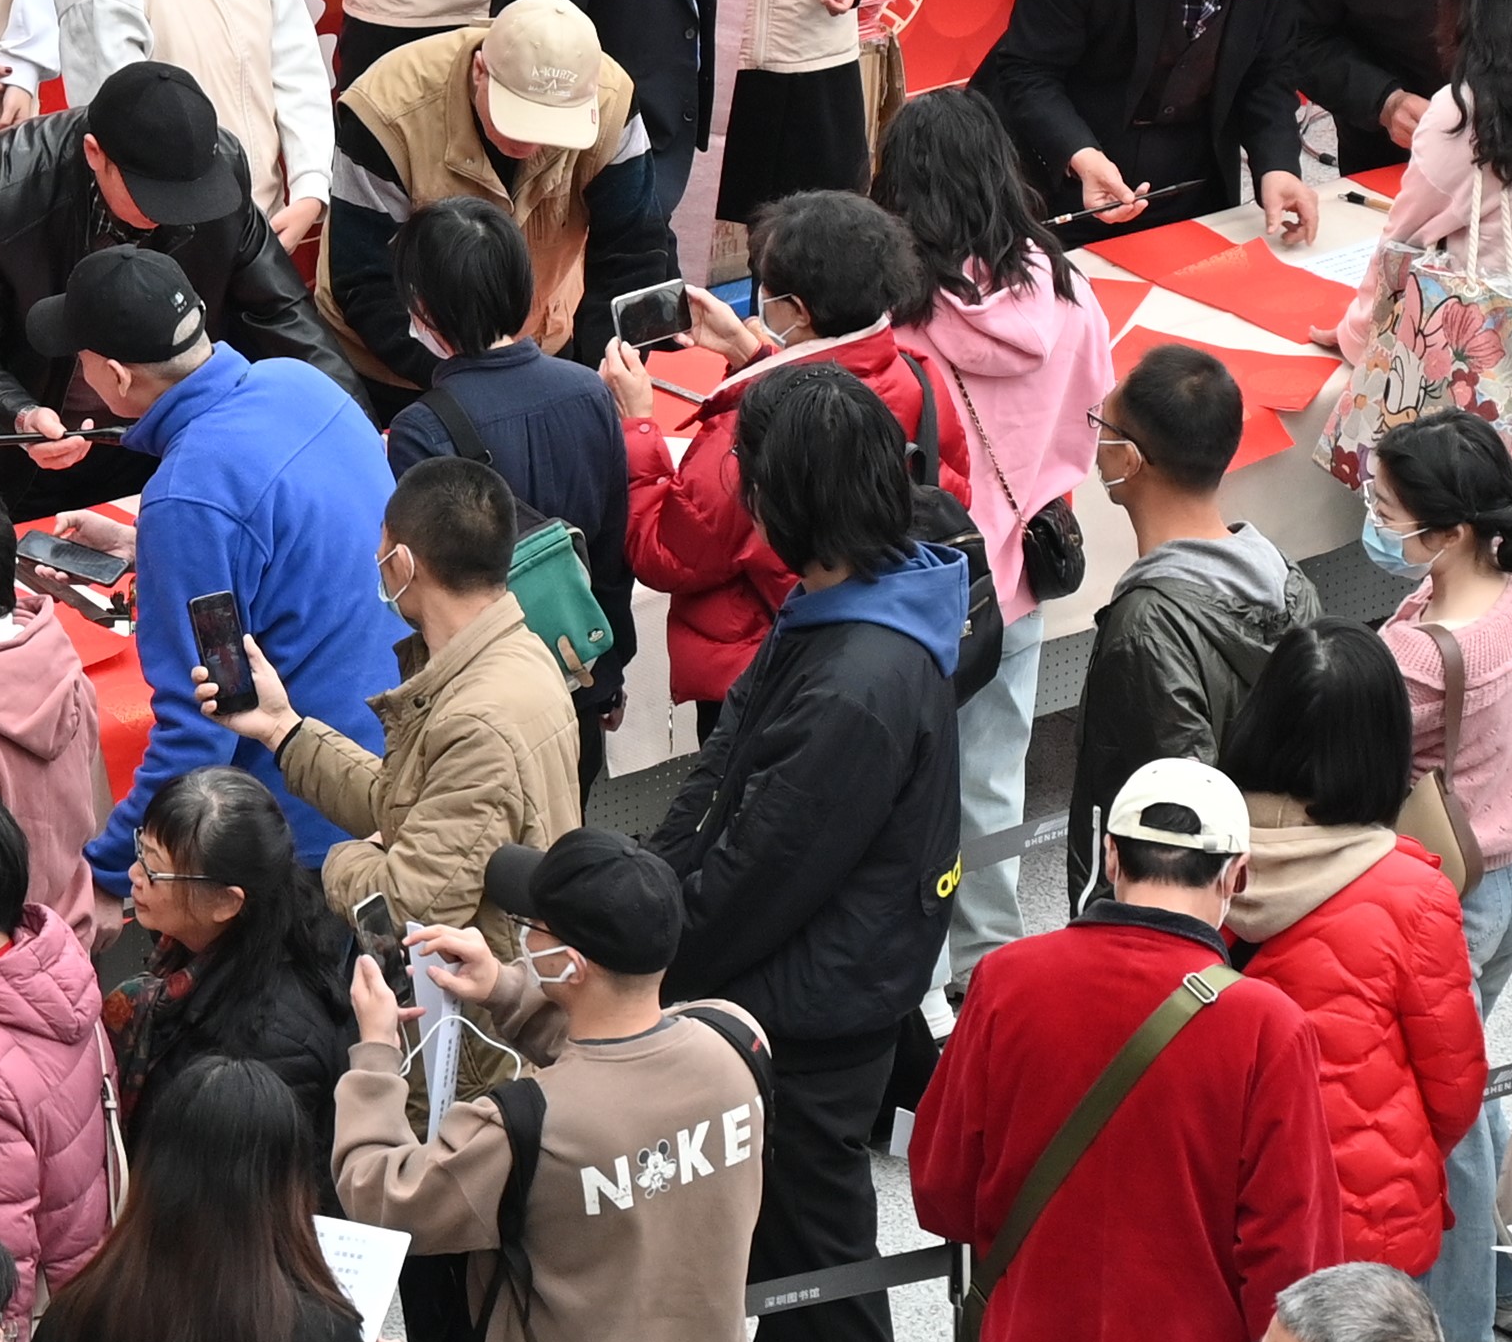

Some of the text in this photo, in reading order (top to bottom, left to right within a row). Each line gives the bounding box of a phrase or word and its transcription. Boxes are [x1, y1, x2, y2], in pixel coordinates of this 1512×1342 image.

[531, 65, 578, 84] A-KURTZ
[764, 1286, 821, 1309] 深圳图书馆
